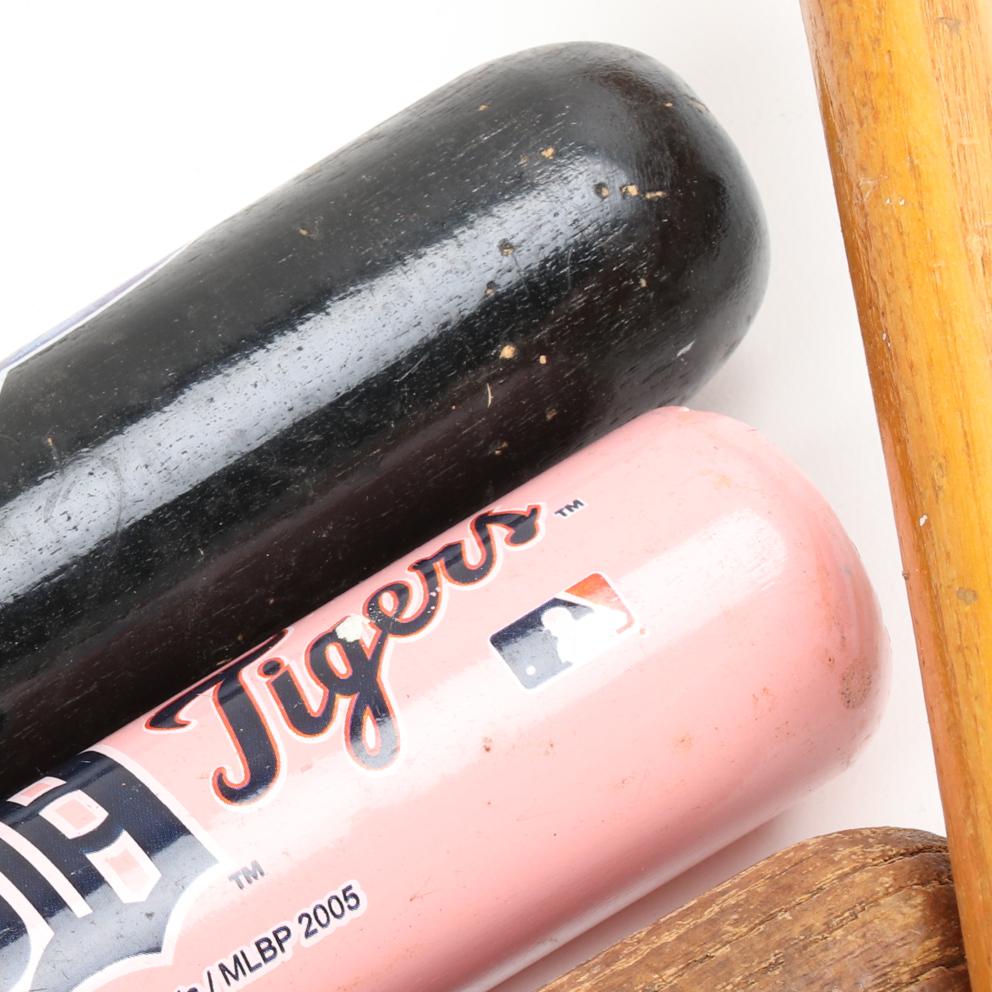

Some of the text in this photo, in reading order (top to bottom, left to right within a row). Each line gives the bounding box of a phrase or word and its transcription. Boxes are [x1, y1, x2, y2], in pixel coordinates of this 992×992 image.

[145, 504, 542, 805] Tigers
[218, 925, 293, 989] MLBP
[297, 883, 362, 939] 2005
